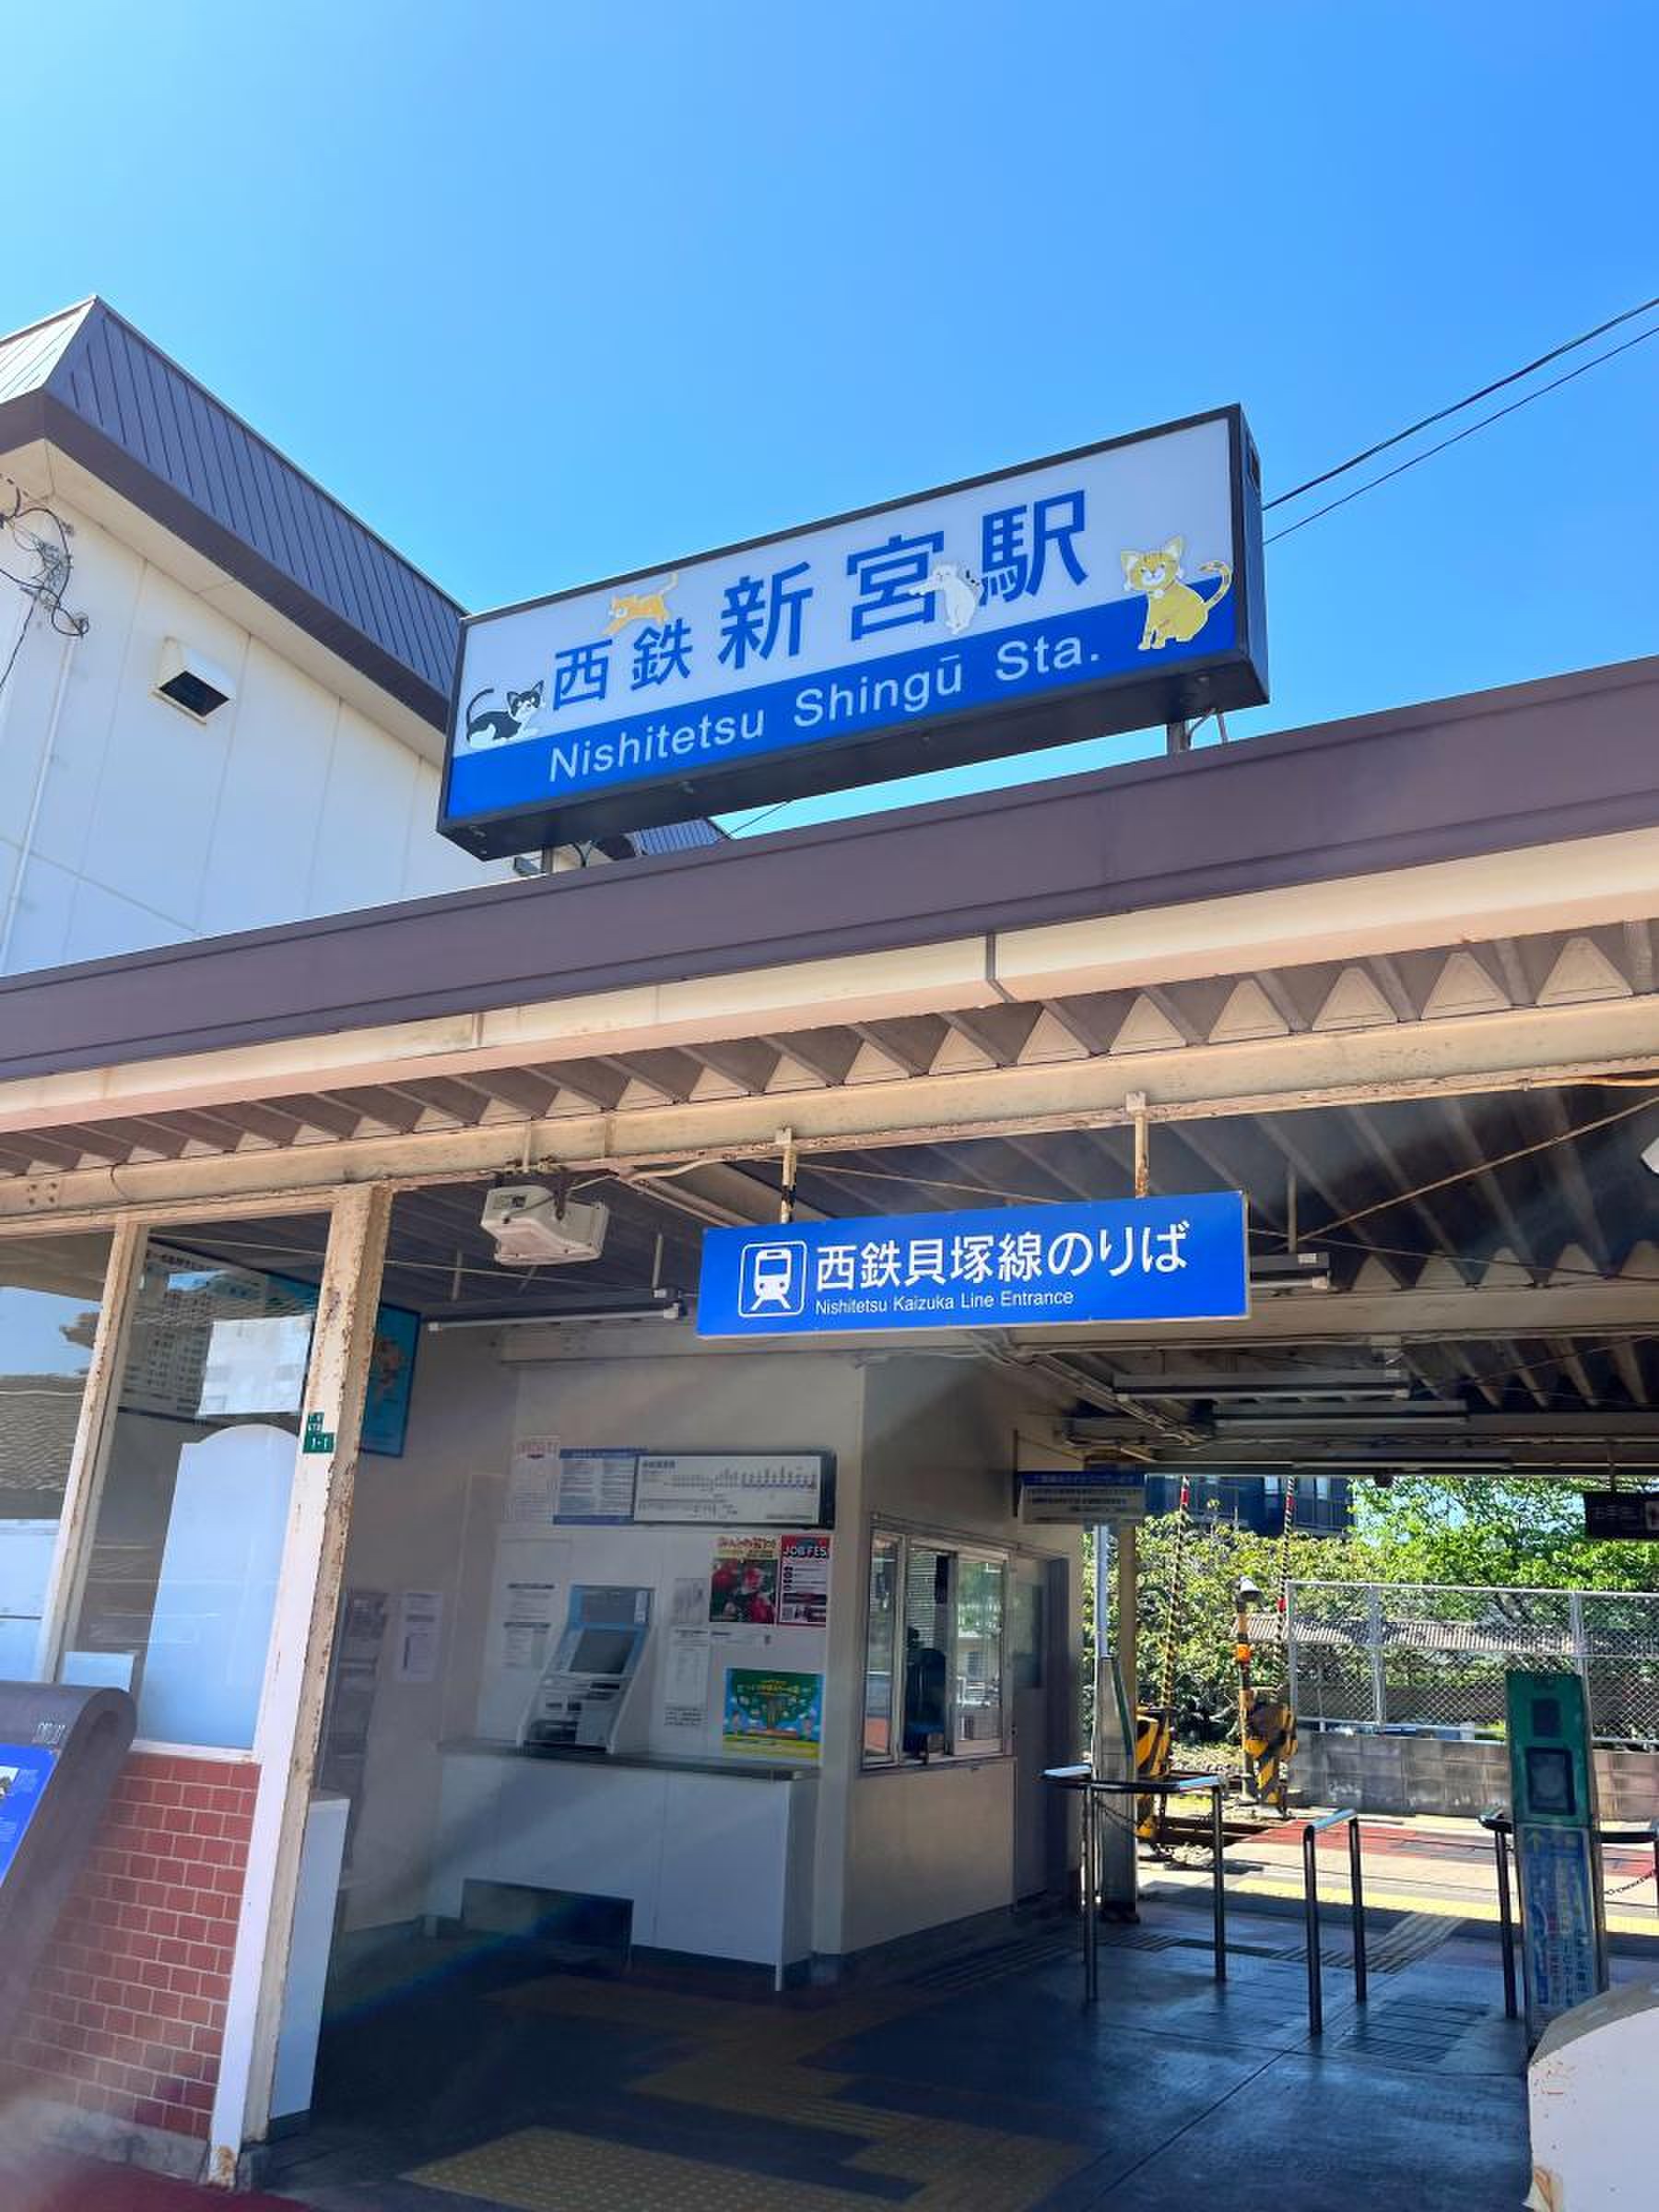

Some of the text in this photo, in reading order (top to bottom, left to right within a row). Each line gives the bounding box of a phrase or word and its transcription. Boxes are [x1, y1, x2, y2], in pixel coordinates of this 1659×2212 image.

[549, 635, 1100, 782] Nishitetsu Shingū Sta.
[816, 1220, 1191, 1292] 西鉄貝塚線のりば
[816, 1289, 1075, 1316] Nishitetsu Kaizuka Line Entrance
